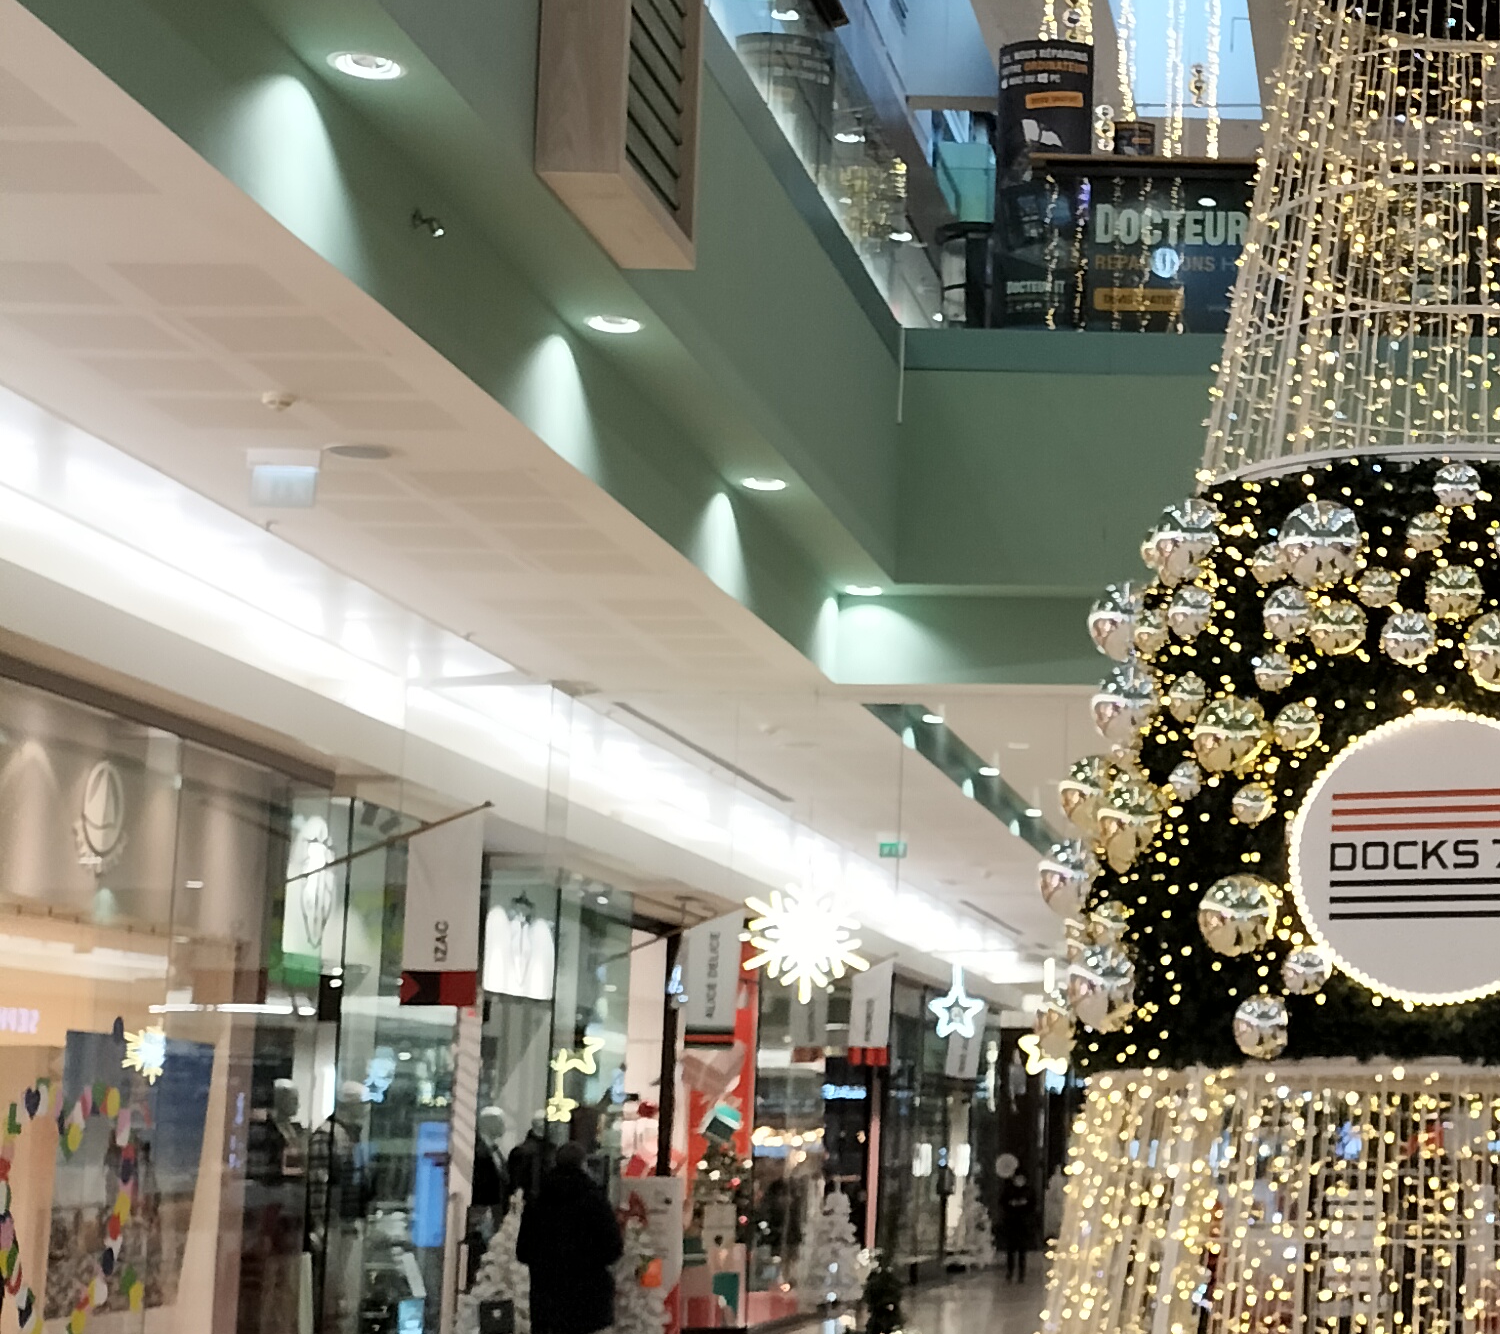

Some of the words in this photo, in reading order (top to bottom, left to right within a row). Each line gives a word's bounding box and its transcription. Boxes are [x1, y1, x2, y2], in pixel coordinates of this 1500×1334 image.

[1095, 203, 1249, 246] DOCTEUR
[1329, 839, 1479, 872] DOCKS
[434, 920, 449, 963] IZAC
